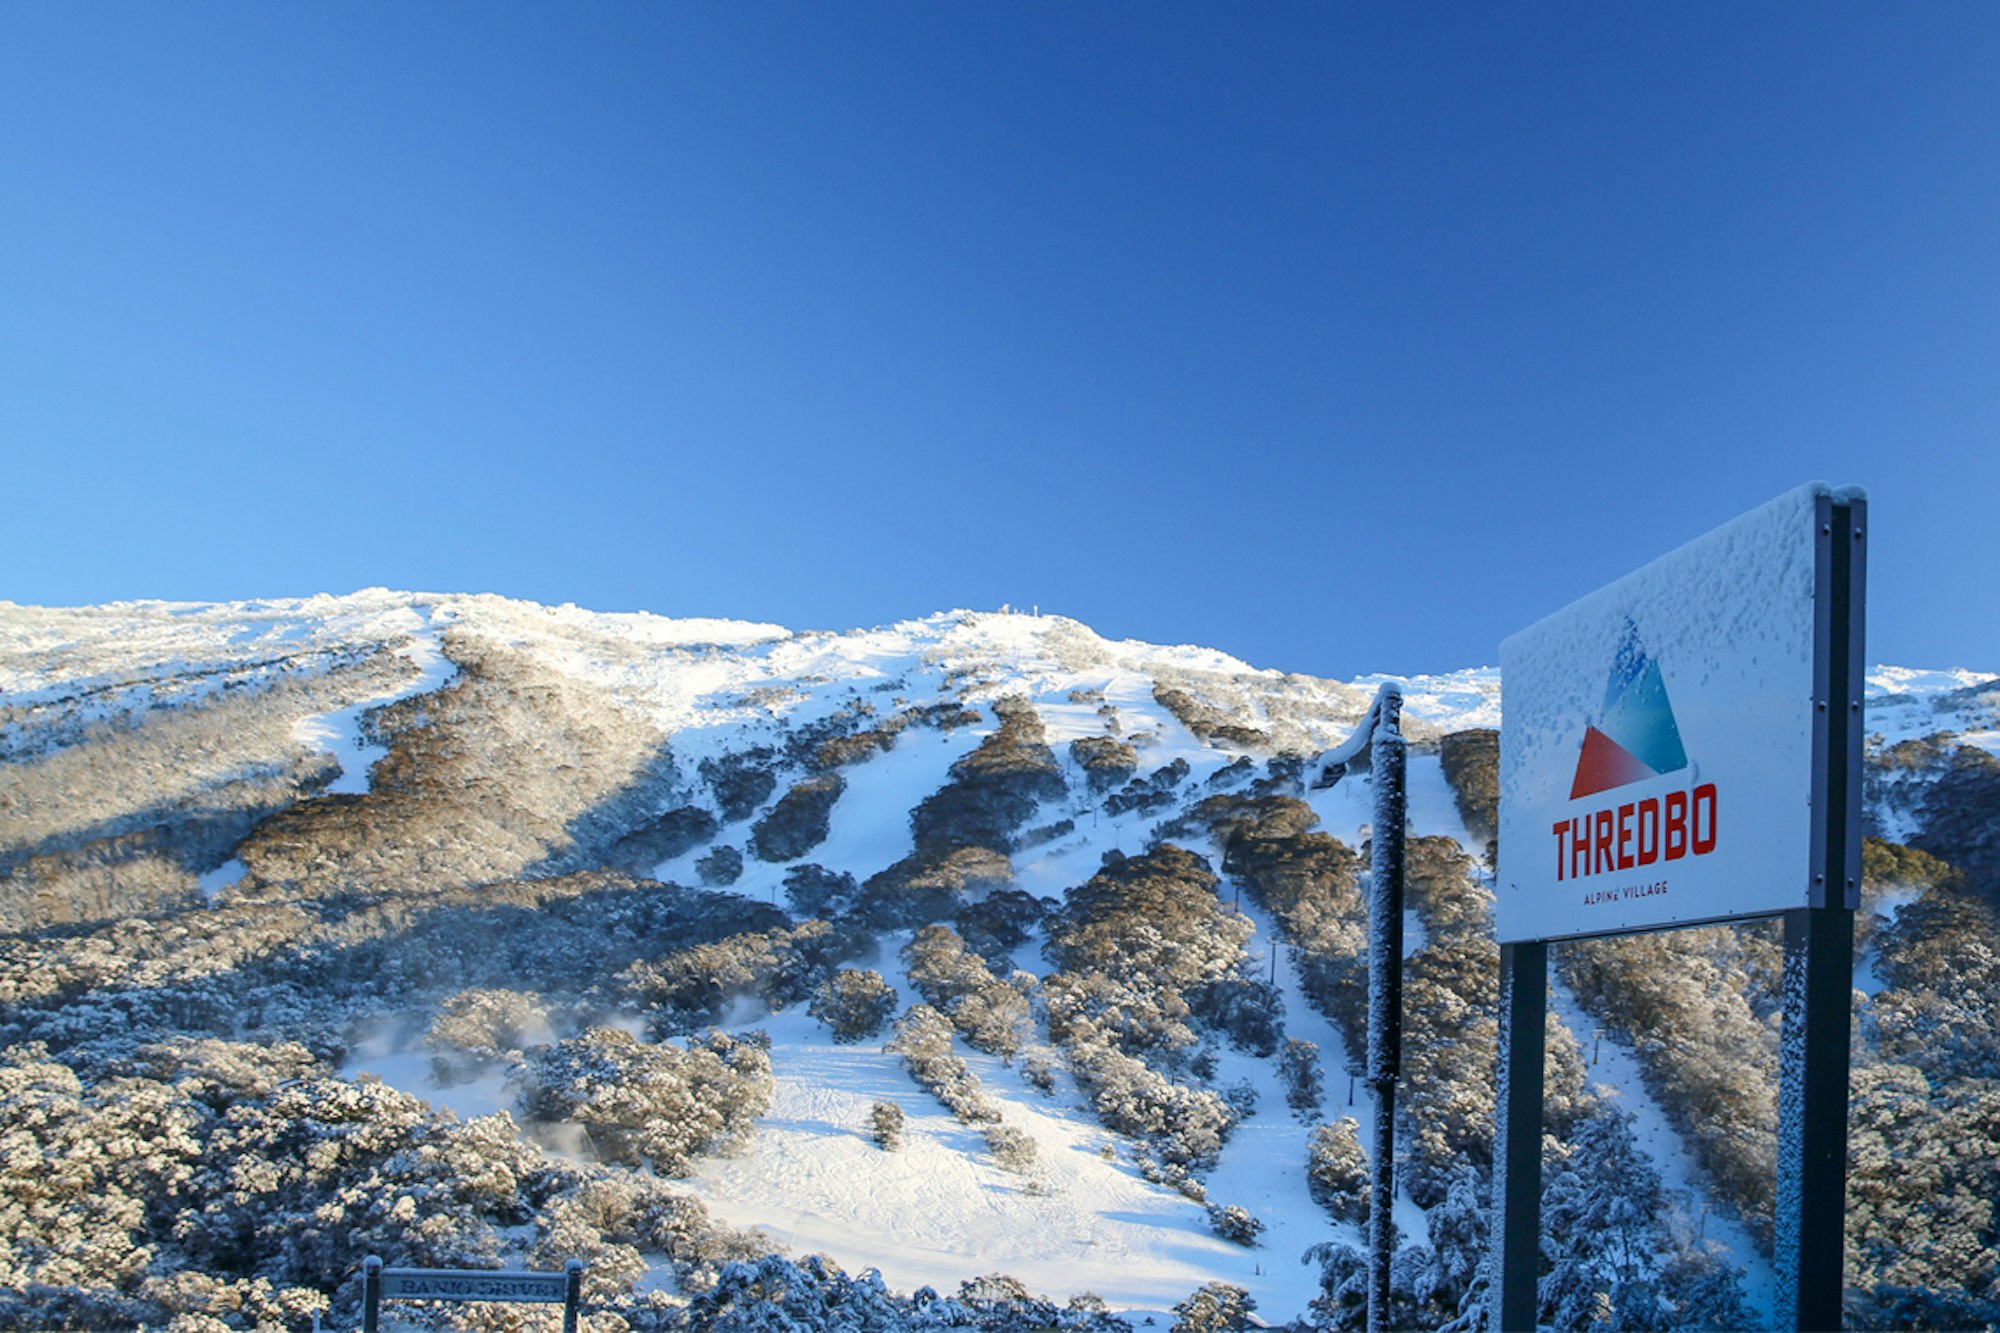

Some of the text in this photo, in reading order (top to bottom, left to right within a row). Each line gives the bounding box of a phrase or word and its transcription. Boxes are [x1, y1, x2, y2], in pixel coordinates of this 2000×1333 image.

[1553, 783, 1717, 881] THREDBO
[1584, 880, 1668, 906] ALPINE VILLAGE
